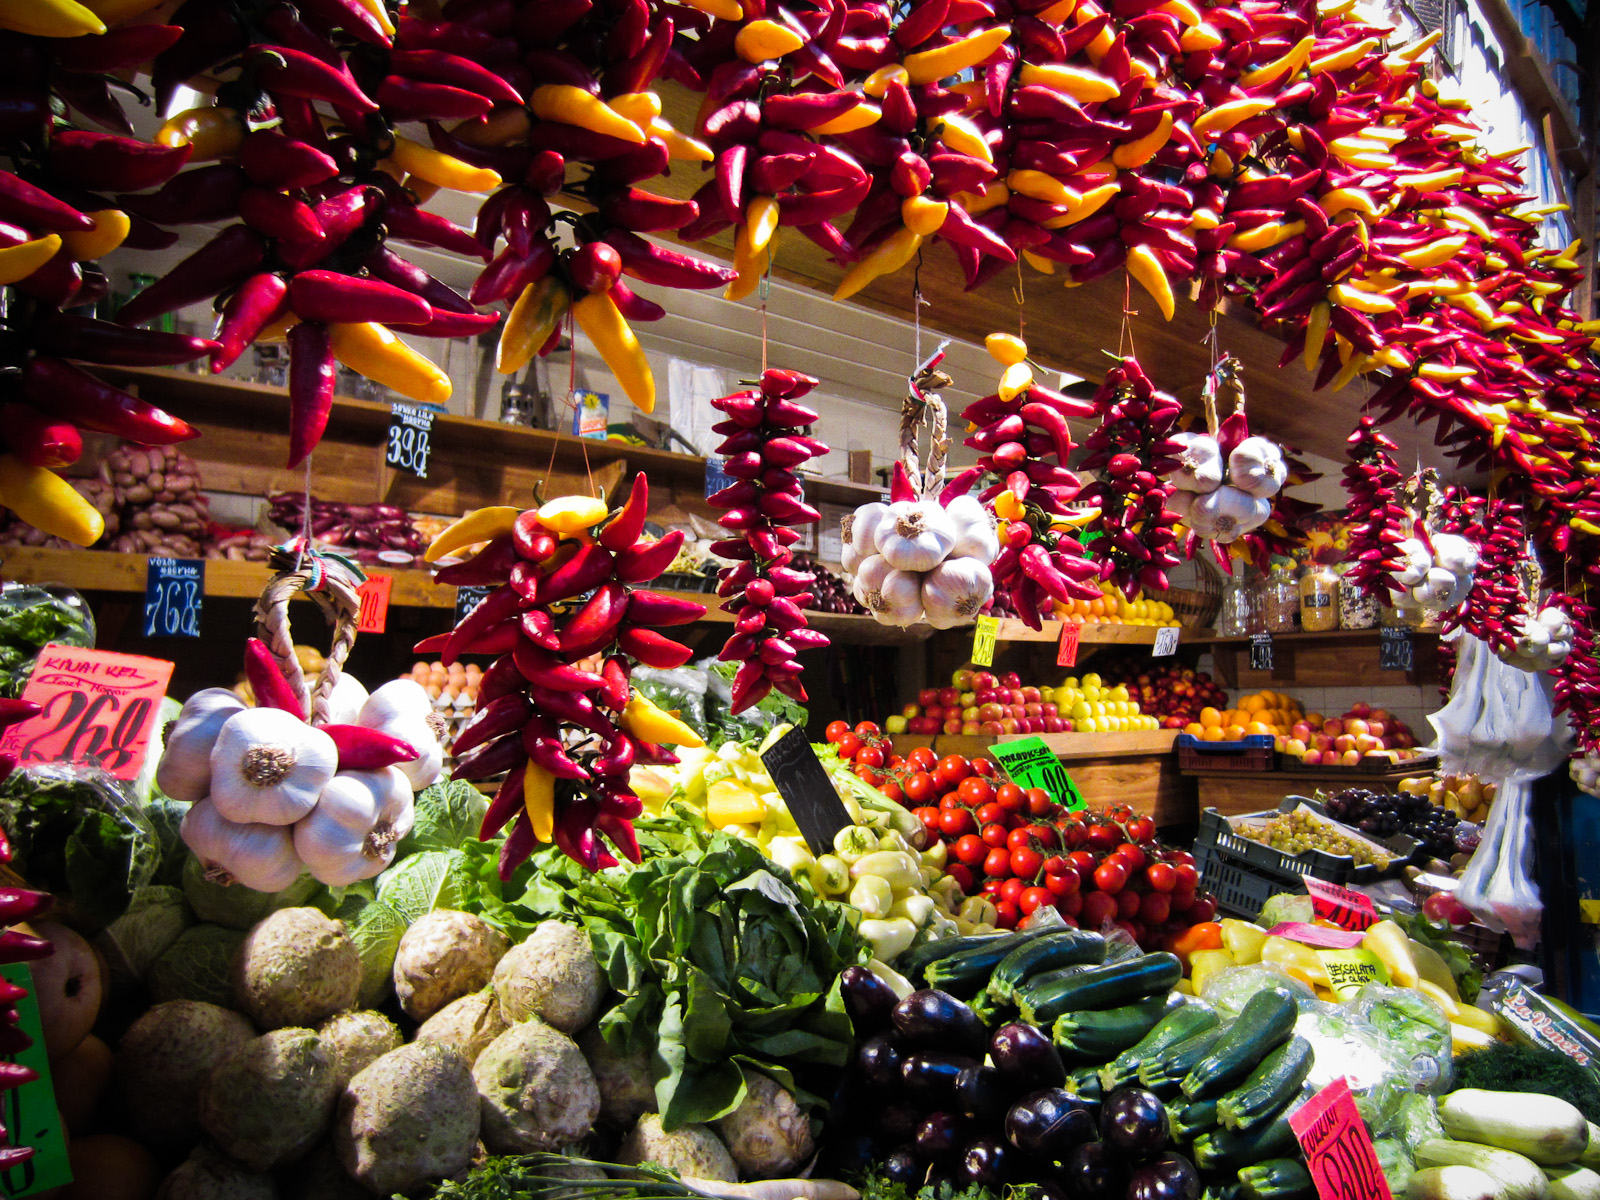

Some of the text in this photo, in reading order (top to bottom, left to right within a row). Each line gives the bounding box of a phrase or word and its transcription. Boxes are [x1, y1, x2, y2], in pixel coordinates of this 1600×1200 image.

[387, 425, 428, 471] 398
[1503, 994, 1532, 1020] La
[1532, 1011, 1590, 1067] Veneta
